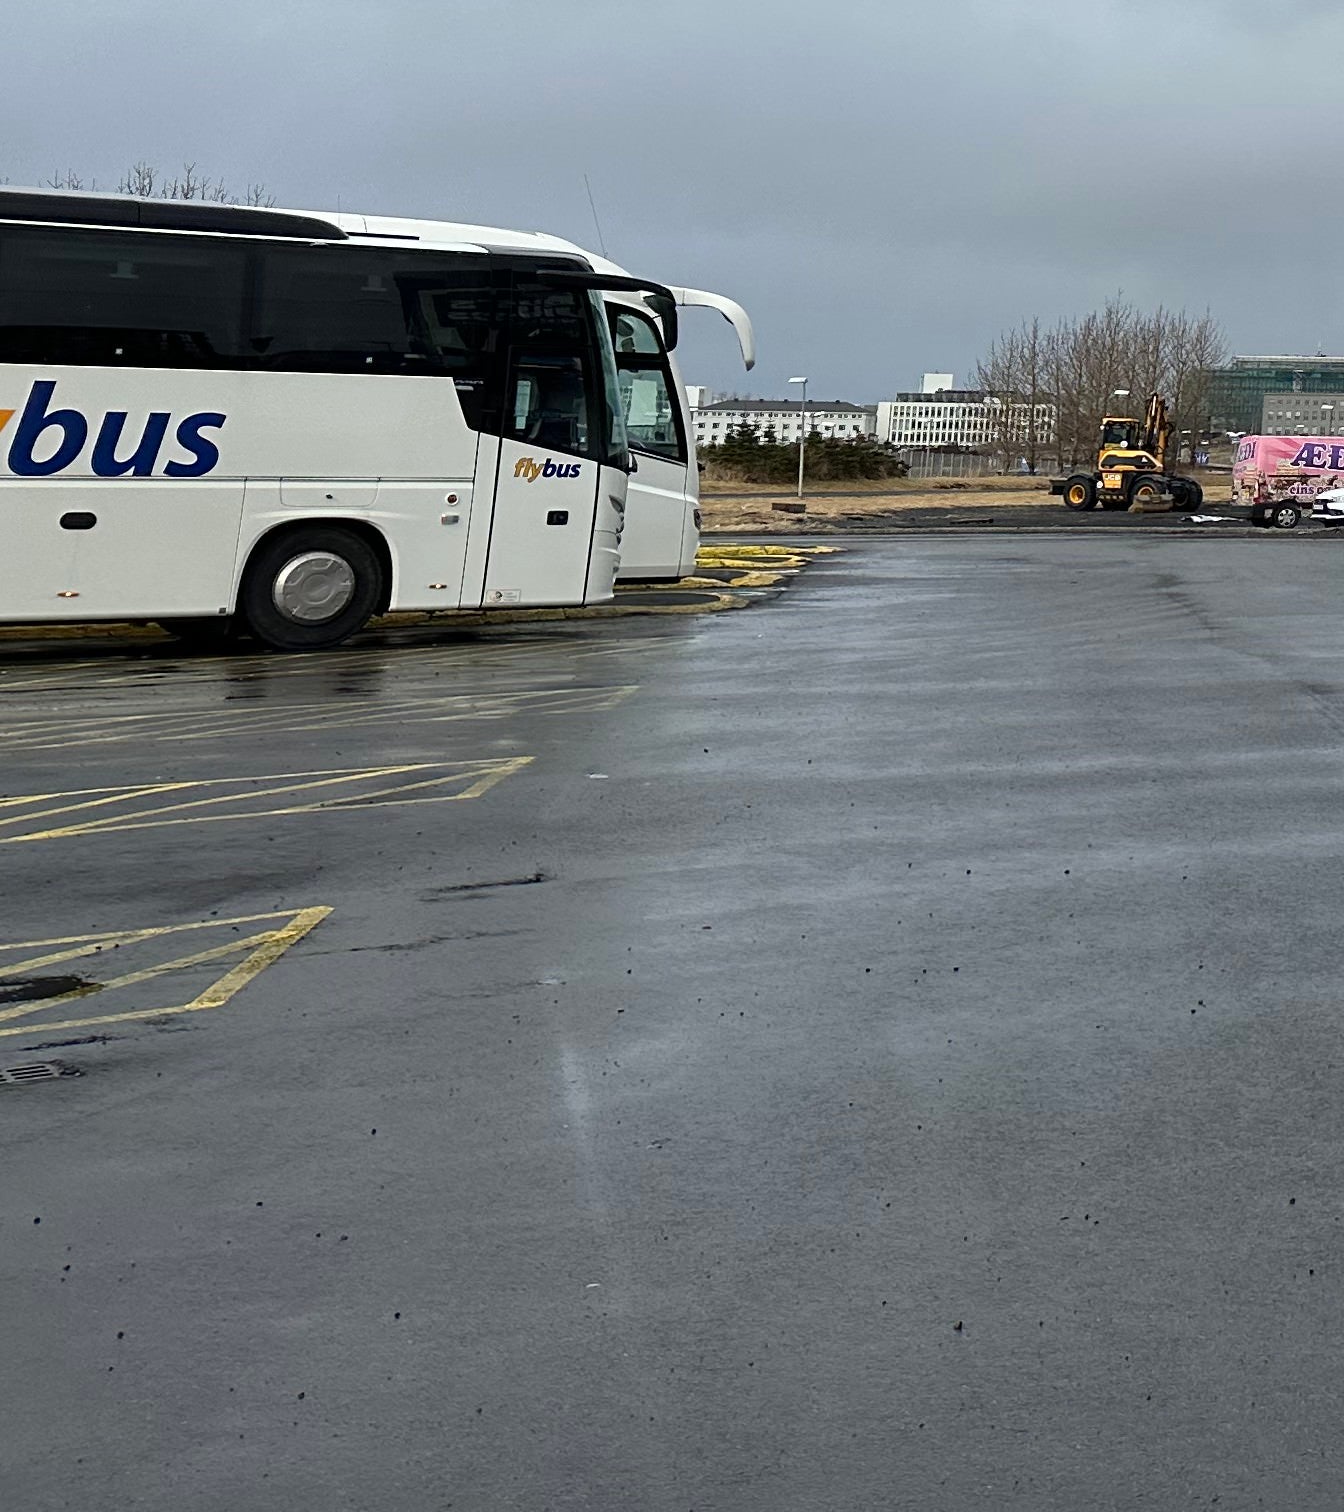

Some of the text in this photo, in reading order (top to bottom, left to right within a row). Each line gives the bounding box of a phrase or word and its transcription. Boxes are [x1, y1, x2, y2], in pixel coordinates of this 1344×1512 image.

[0, 380, 227, 478] bus
[513, 457, 582, 484] flybus
[1289, 484, 1314, 495] eins
